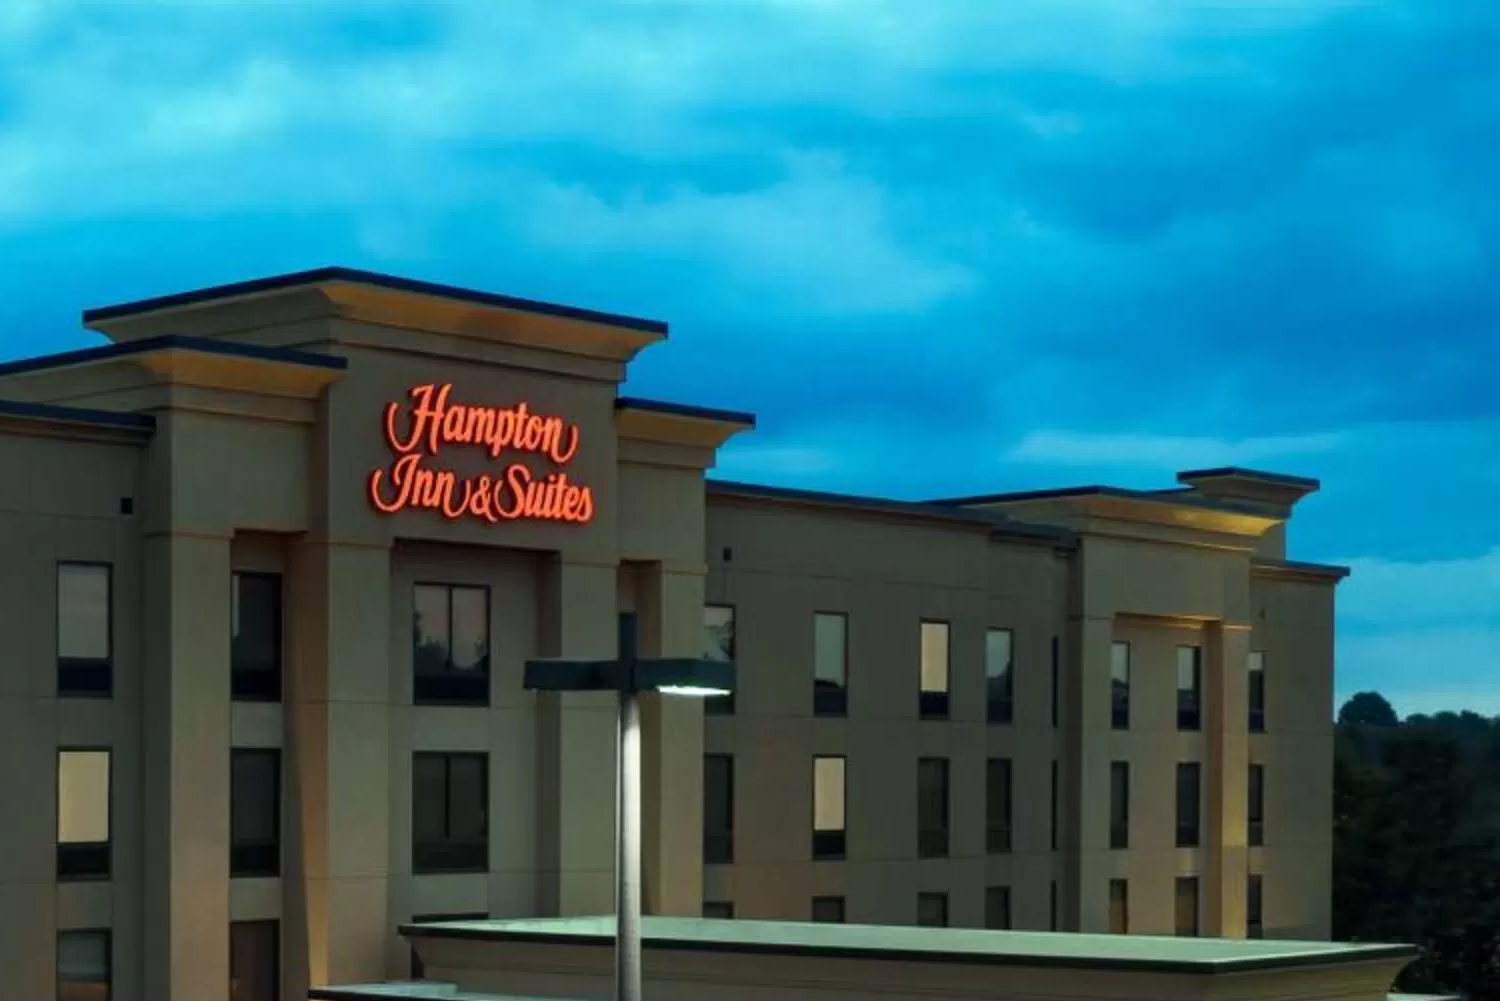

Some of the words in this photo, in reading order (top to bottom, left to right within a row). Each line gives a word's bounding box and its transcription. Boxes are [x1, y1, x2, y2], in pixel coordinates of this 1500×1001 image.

[387, 383, 579, 463] Hampton
[371, 453, 471, 517] Inn
[470, 476, 497, 522] &
[493, 463, 594, 522] Suites
